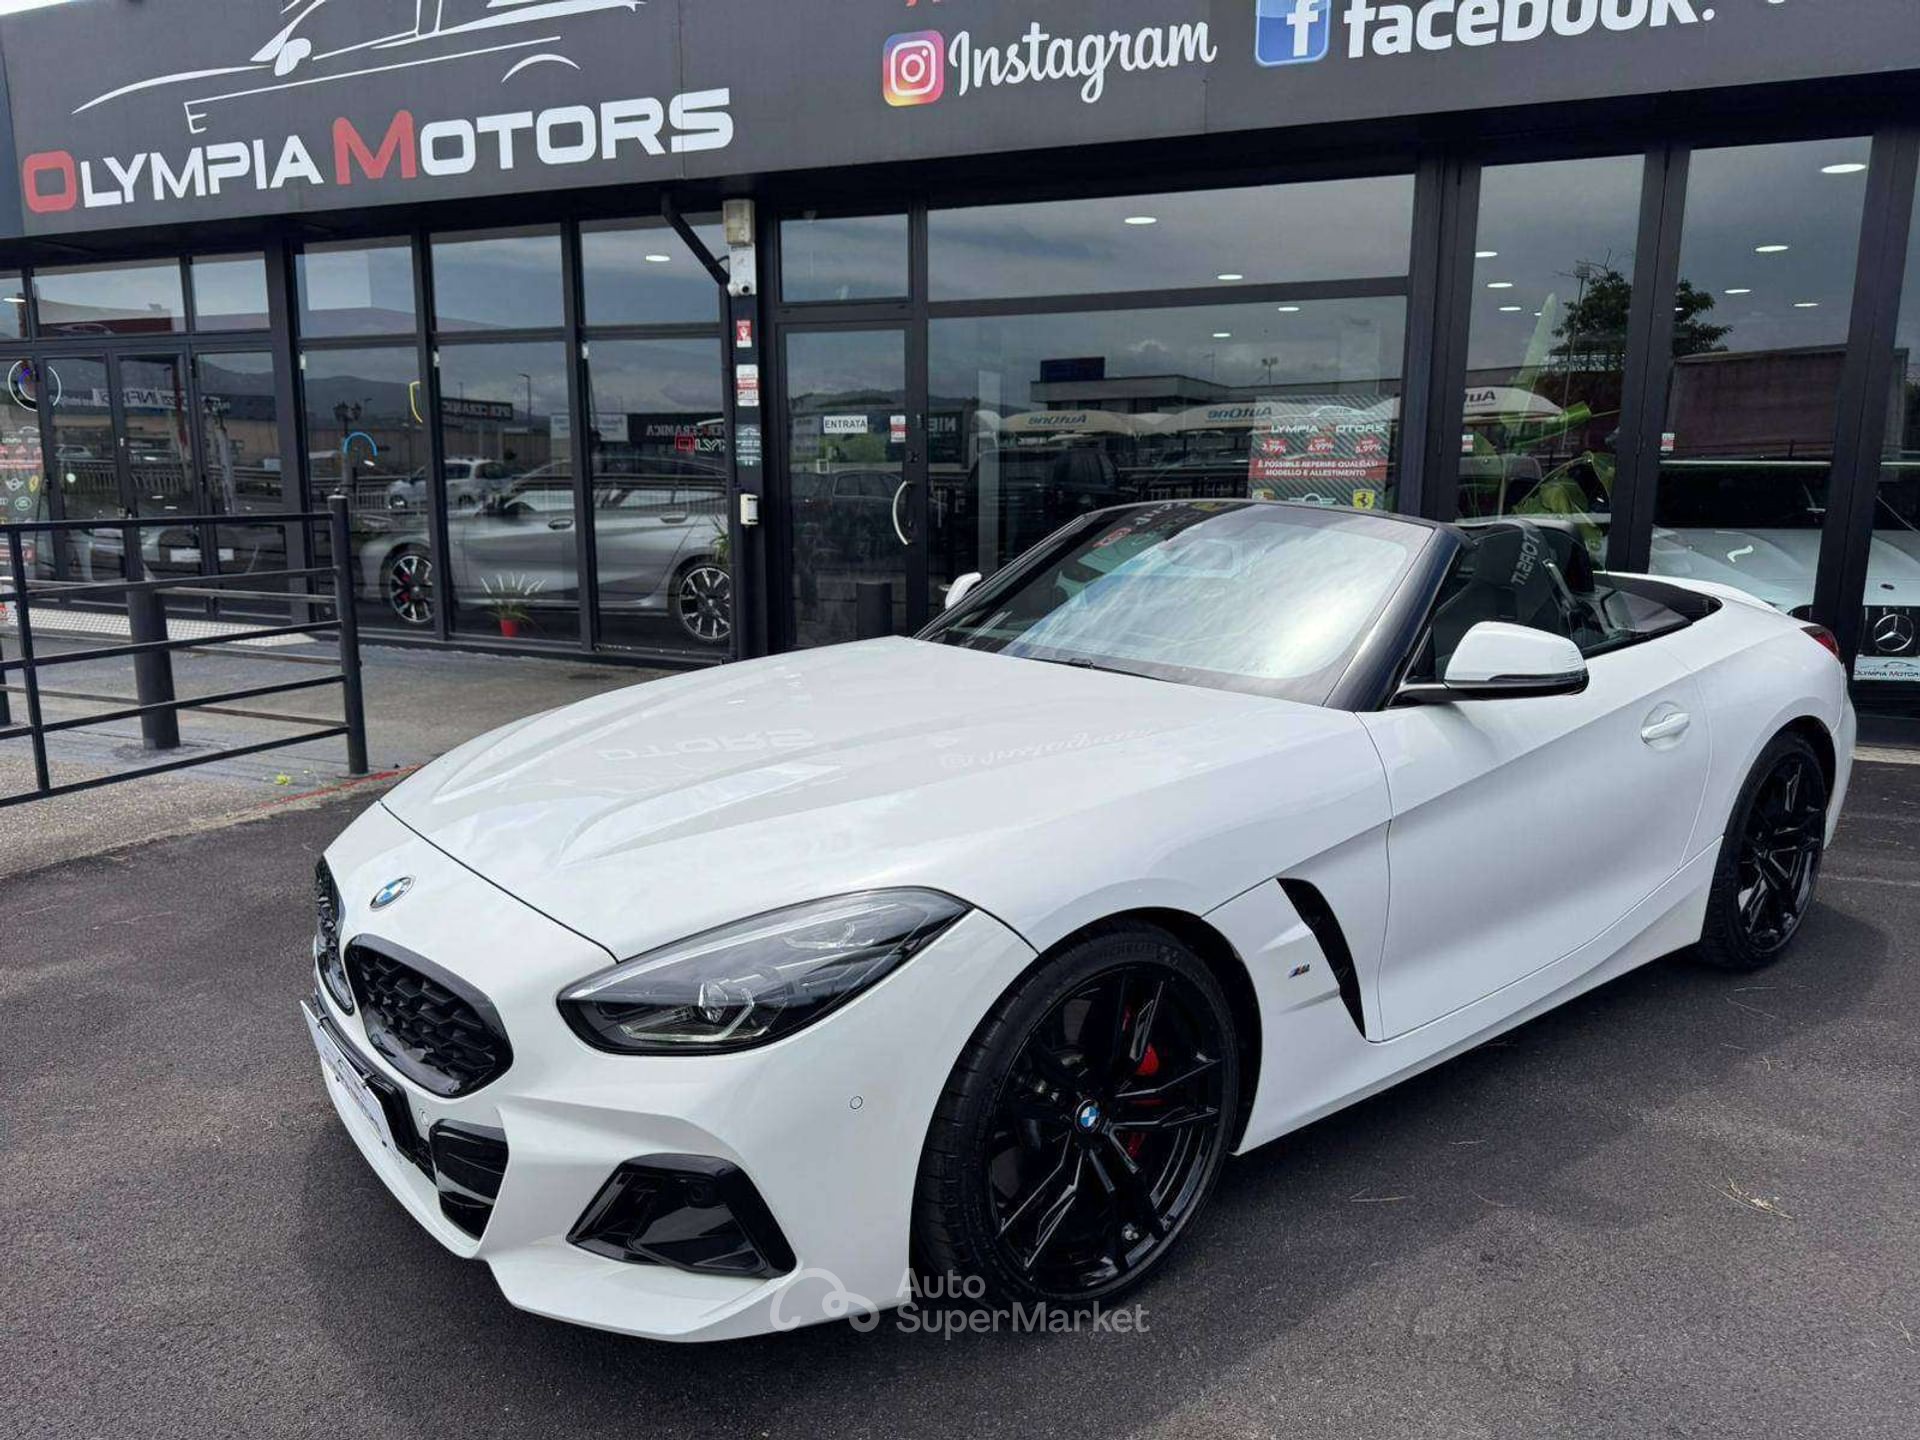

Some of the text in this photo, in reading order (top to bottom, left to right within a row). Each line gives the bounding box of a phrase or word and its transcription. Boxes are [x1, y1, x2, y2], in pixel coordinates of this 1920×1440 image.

[948, 21, 1218, 104] Instagram
[22, 88, 735, 213] OLYMPIA MOTORS
[824, 419, 867, 429] ENTRATA
[1265, 469, 1301, 477] MODELLO
[1309, 469, 1366, 477] ALLESTIMENTO
